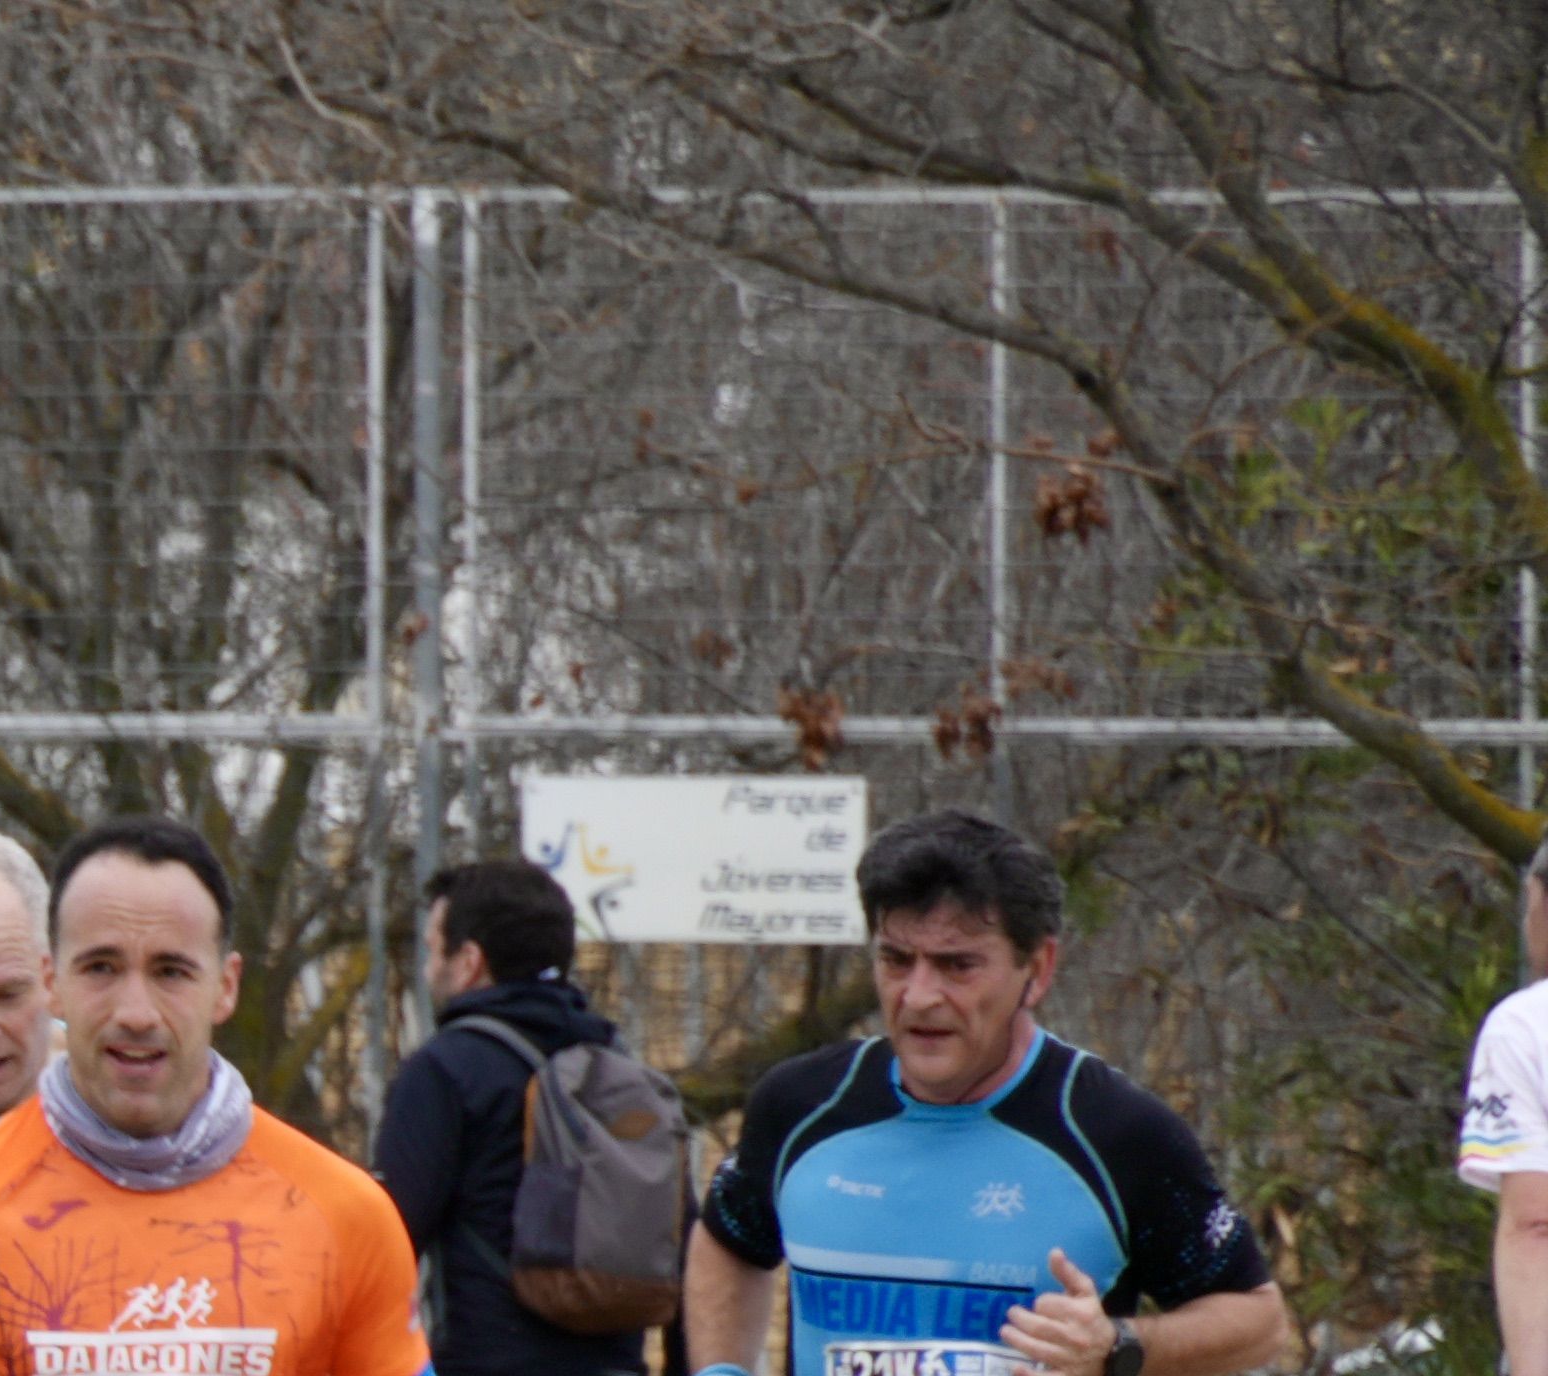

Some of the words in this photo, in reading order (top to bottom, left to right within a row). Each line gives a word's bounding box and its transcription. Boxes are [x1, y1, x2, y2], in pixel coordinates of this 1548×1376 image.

[723, 786, 847, 818] Parque
[805, 824, 847, 852] de
[701, 857, 846, 893] Jóvenes
[698, 903, 847, 942] Mayores
